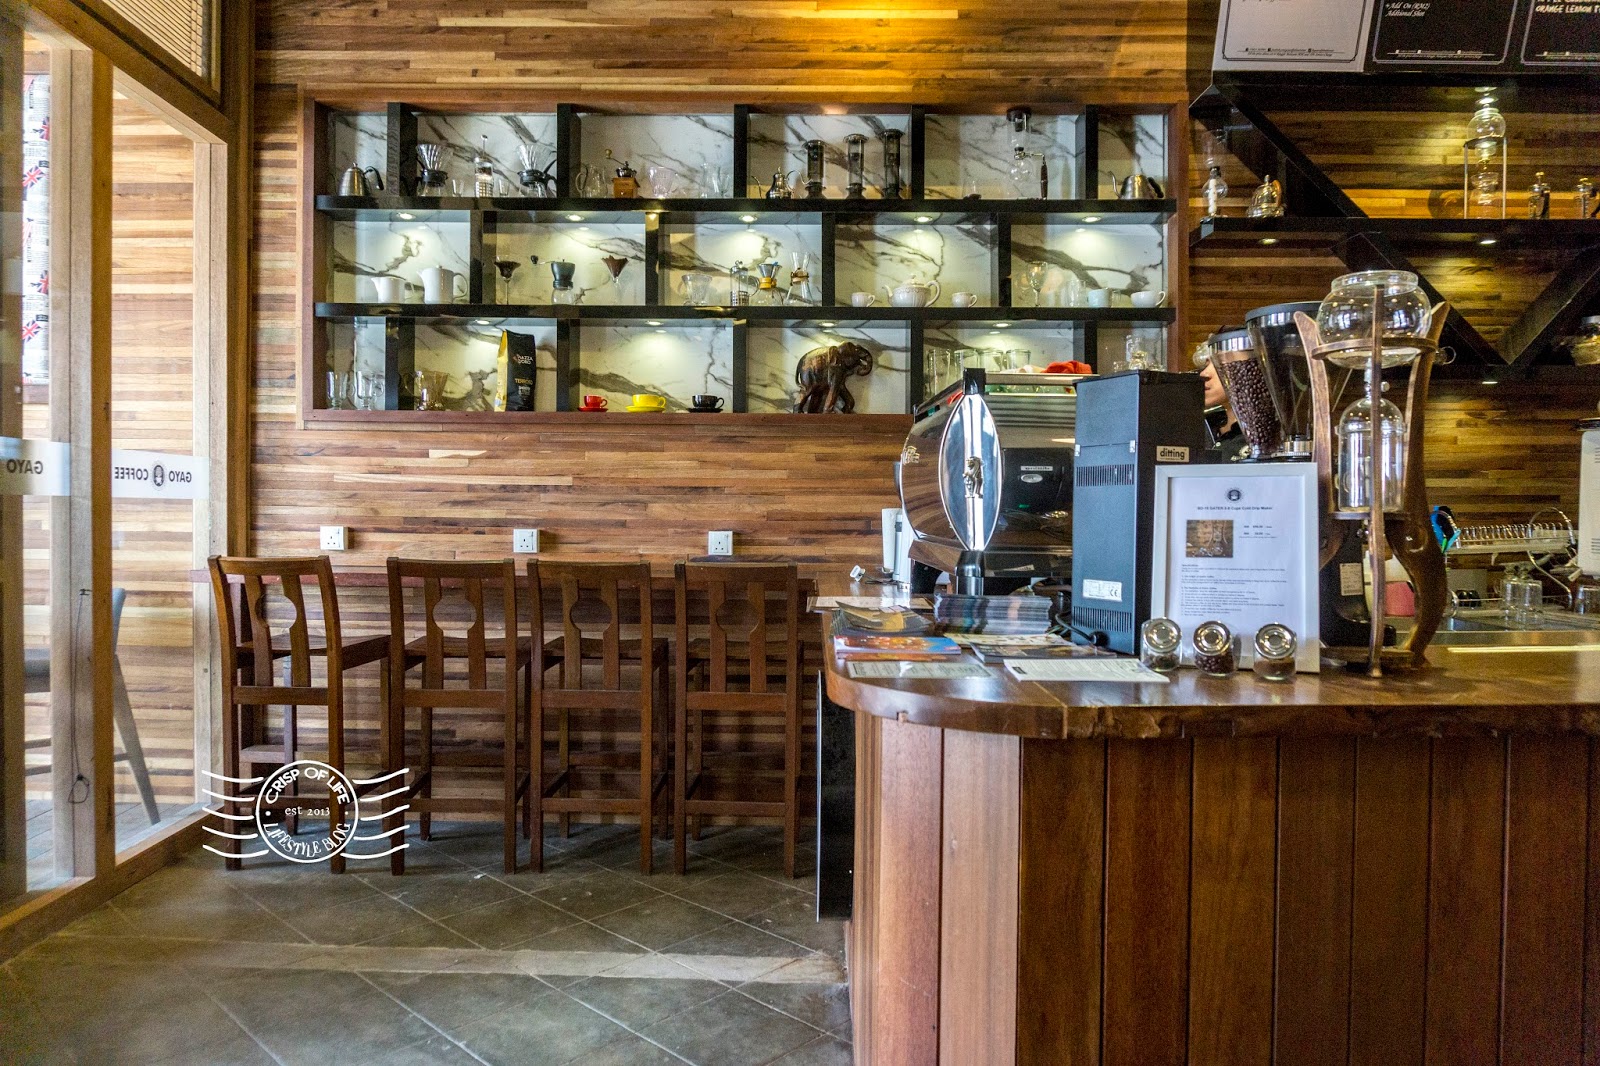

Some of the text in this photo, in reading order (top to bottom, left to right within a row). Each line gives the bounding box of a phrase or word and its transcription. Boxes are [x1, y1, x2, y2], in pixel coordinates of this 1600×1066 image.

[1535, 4, 1564, 14] ORANGE
[1565, 4, 1592, 14] LEMON
[1159, 448, 1185, 460] ditting
